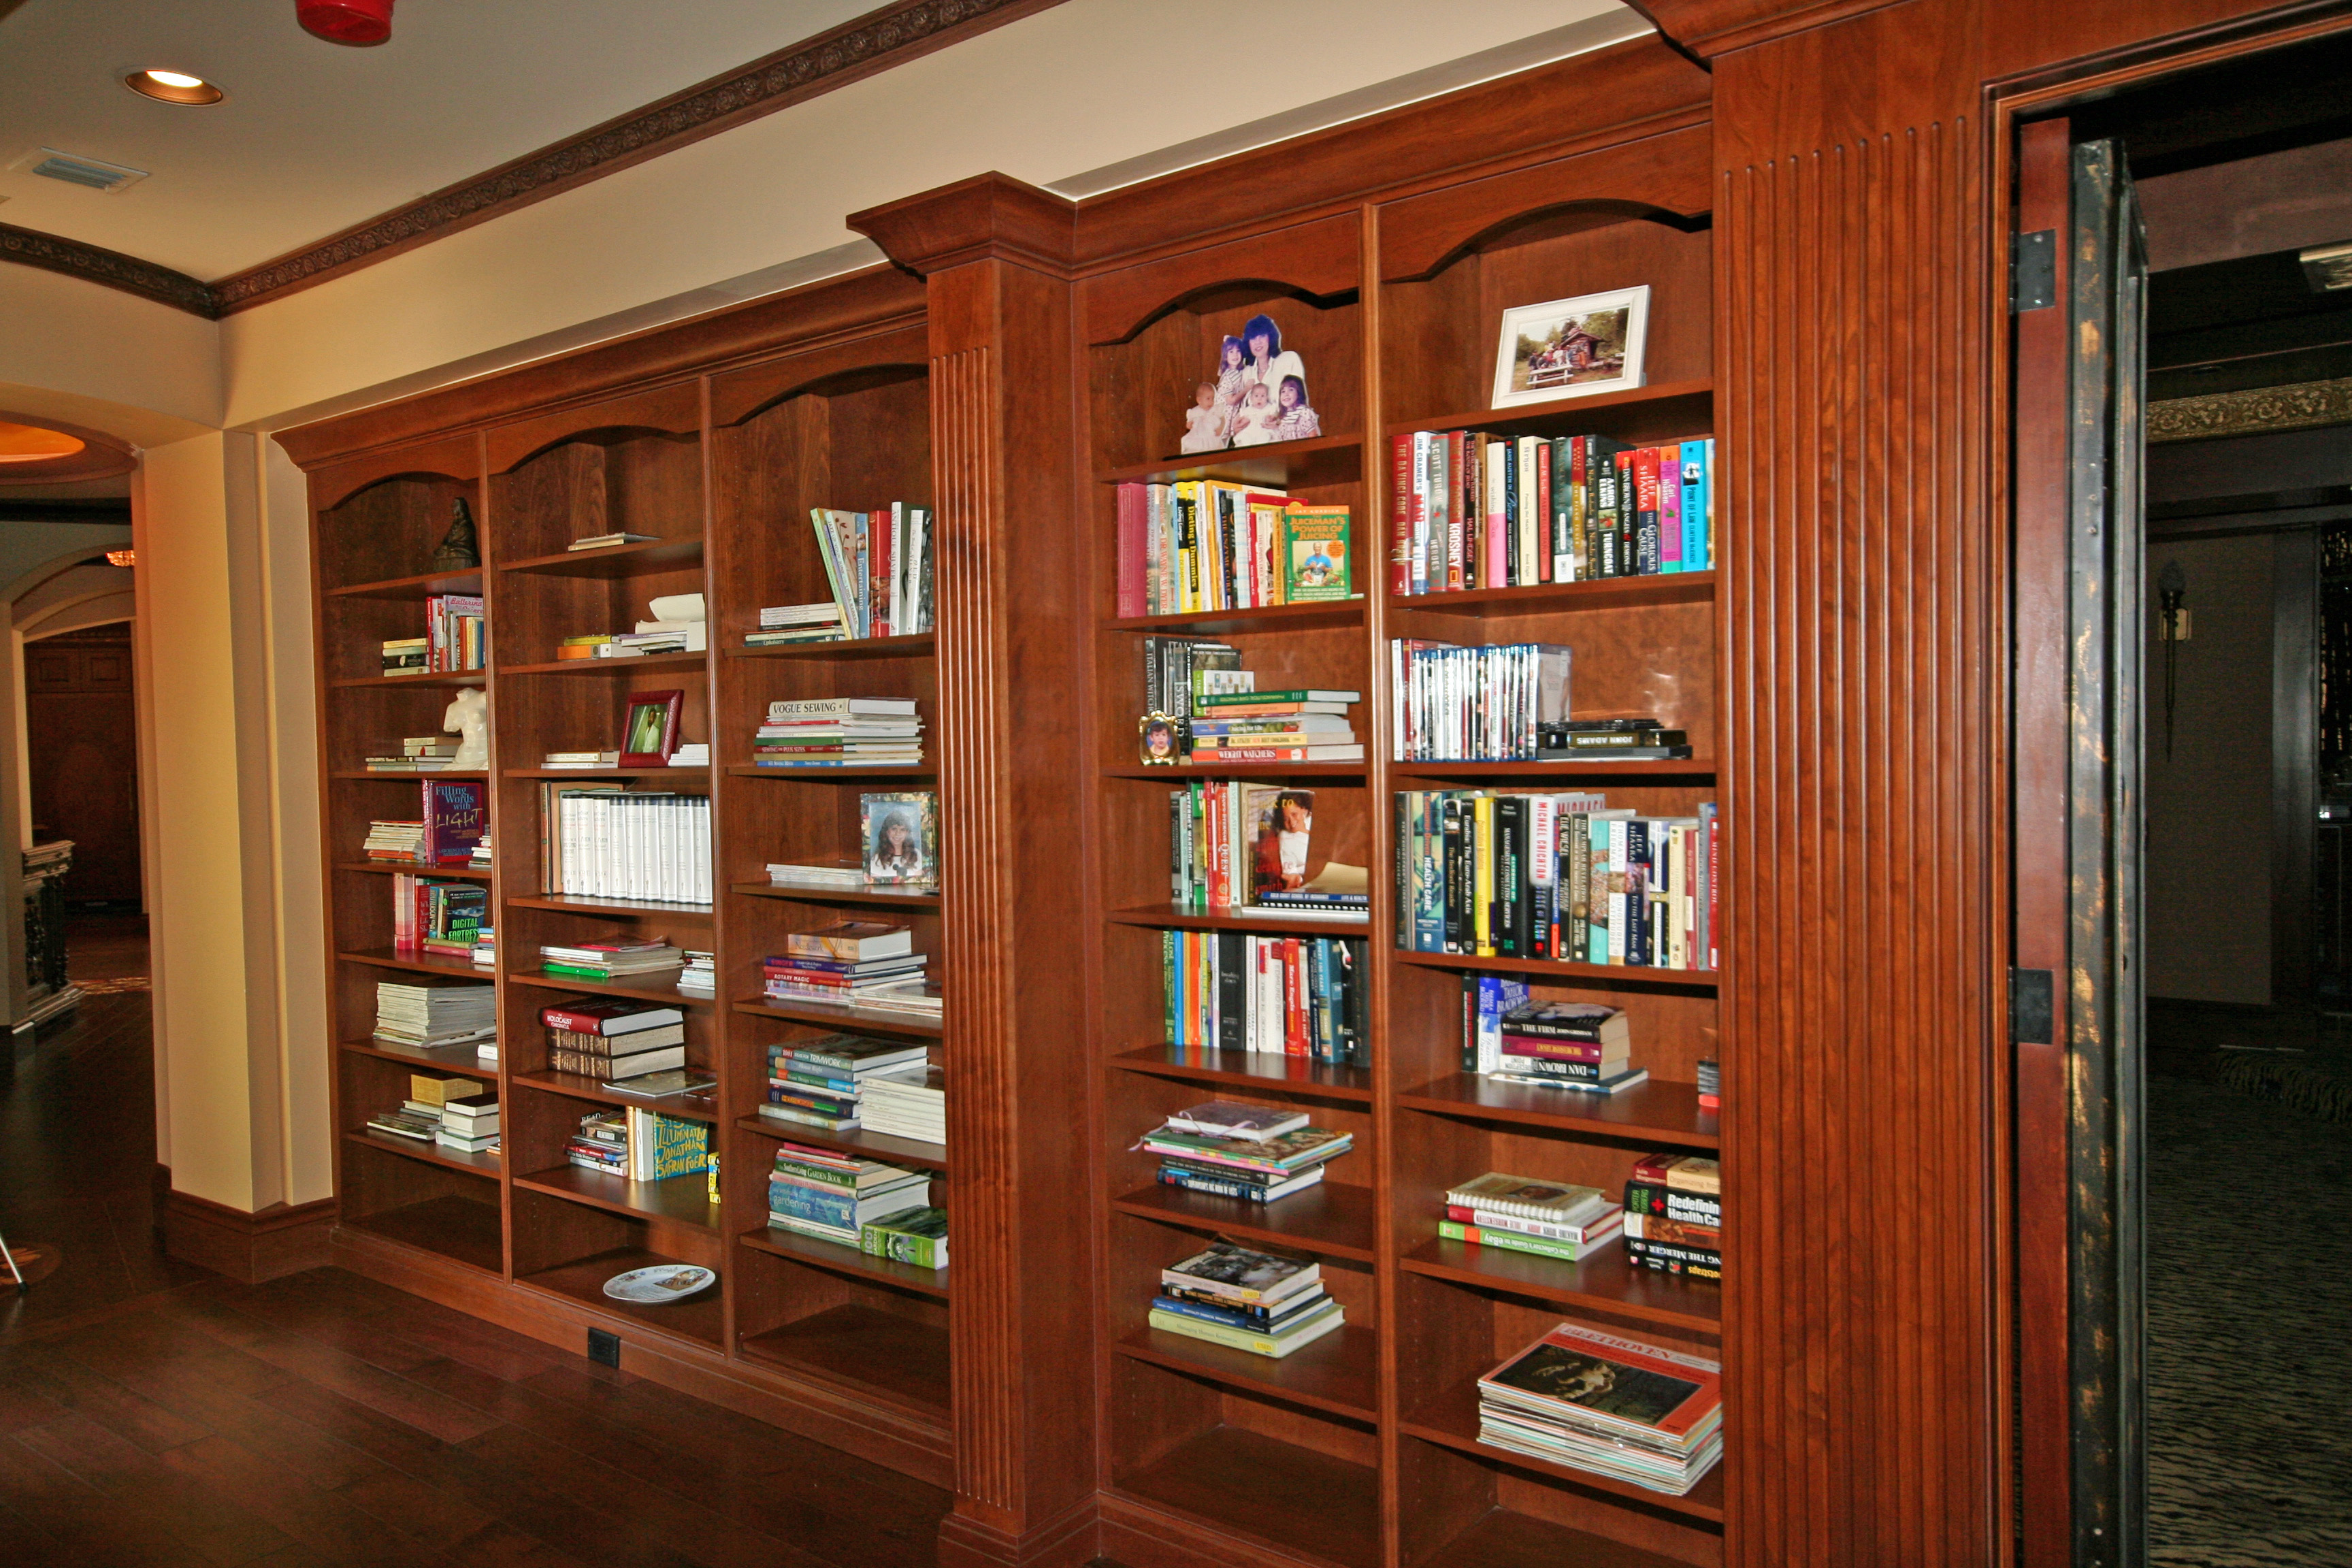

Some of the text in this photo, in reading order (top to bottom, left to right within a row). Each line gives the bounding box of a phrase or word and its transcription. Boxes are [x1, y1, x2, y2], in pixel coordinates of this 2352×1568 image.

[1432, 442, 1443, 502] SCOTT TUROW
[1396, 444, 1407, 536] THE DA VINCI CODE DAN
[1599, 478, 1607, 508] ELKINS
[1607, 478, 1615, 507] AARON
[1622, 483, 1631, 504] BROWN
[1639, 466, 1648, 508] SHAARA
[1648, 476, 1656, 497] JEFF
[1662, 479, 1670, 504] Hiaasen
[1668, 484, 1676, 497] Carl
[1688, 487, 1696, 502] POINT
[1290, 516, 1345, 525] JUICEMAN'S
[1688, 512, 1696, 523] LAW
[1298, 532, 1339, 540] JUICING
[1449, 523, 1461, 567] KROSNEY
[1639, 527, 1648, 555] CAUSE
[1188, 506, 1198, 588] Dieting Dummies
[1431, 539, 1440, 570] HEROES
[1603, 533, 1614, 574] TURNCOAT
[1648, 524, 1656, 571] GLORIOUS
[1160, 552, 1169, 577] WAYNE
[451, 598, 483, 606] Ballerina
[1147, 653, 1155, 682] ITALIAN
[774, 702, 836, 713] VOGUE SEWING
[1219, 749, 1275, 758] WEIGHT WATCHERS
[436, 786, 467, 797] Filling
[446, 794, 474, 803] Words
[1281, 799, 1294, 807] to
[436, 808, 483, 828] LIGHT
[1537, 802, 1548, 879] MICHAEL CRICHTON
[1560, 817, 1569, 856] ELIE WIESEL
[1635, 834, 1644, 853] JEFF
[1219, 844, 1230, 877] QUEST
[1424, 857, 1432, 887] HEALTH
[453, 918, 478, 929] DIGITAL
[1535, 920, 1546, 940] FEAR
[449, 928, 479, 942] FORTRES
[1288, 964, 1296, 1013] Marx-Engels
[547, 1015, 572, 1025] HOLOCAUST
[1521, 1023, 1556, 1034] THE FIRM
[810, 1054, 842, 1067] TRIMWORK
[1538, 1061, 1587, 1076] DAN BROWN
[657, 1139, 706, 1163] JONATHAN
[657, 1158, 686, 1178] SAFRAN
[797, 1166, 806, 1177] Living
[807, 1168, 827, 1180] GARDEN
[828, 1172, 842, 1183] BOOK
[773, 1195, 811, 1214] gardening
[1667, 1193, 1720, 1215] Redefinin
[1667, 1207, 1720, 1226] Health Ca
[1484, 1233, 1504, 1246] eBay
[1512, 1241, 1529, 1249] Guide
[1529, 1243, 1559, 1255] Collector's
[1648, 1245, 1706, 1262] THE MERGER
[1256, 1342, 1272, 1350] USED
[1565, 1327, 1674, 1360] BEETHOVEN
